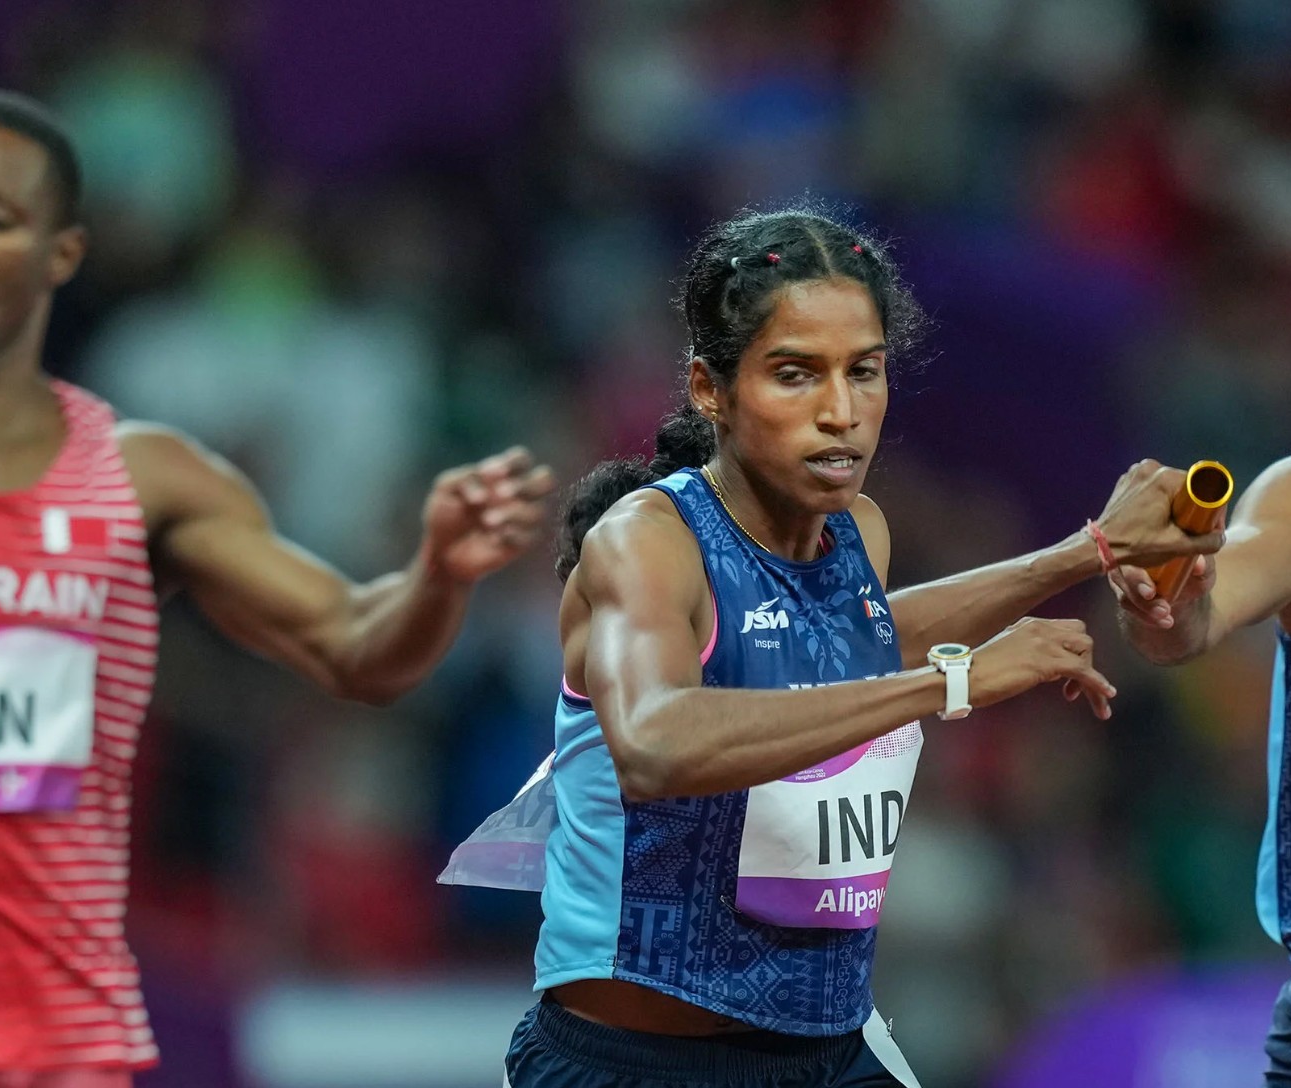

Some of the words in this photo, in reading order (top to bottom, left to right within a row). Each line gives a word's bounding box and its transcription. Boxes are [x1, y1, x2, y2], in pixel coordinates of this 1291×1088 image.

[754, 638, 781, 649] Inspire
[817, 789, 904, 865] IND
[815, 886, 885, 917] Alipay
